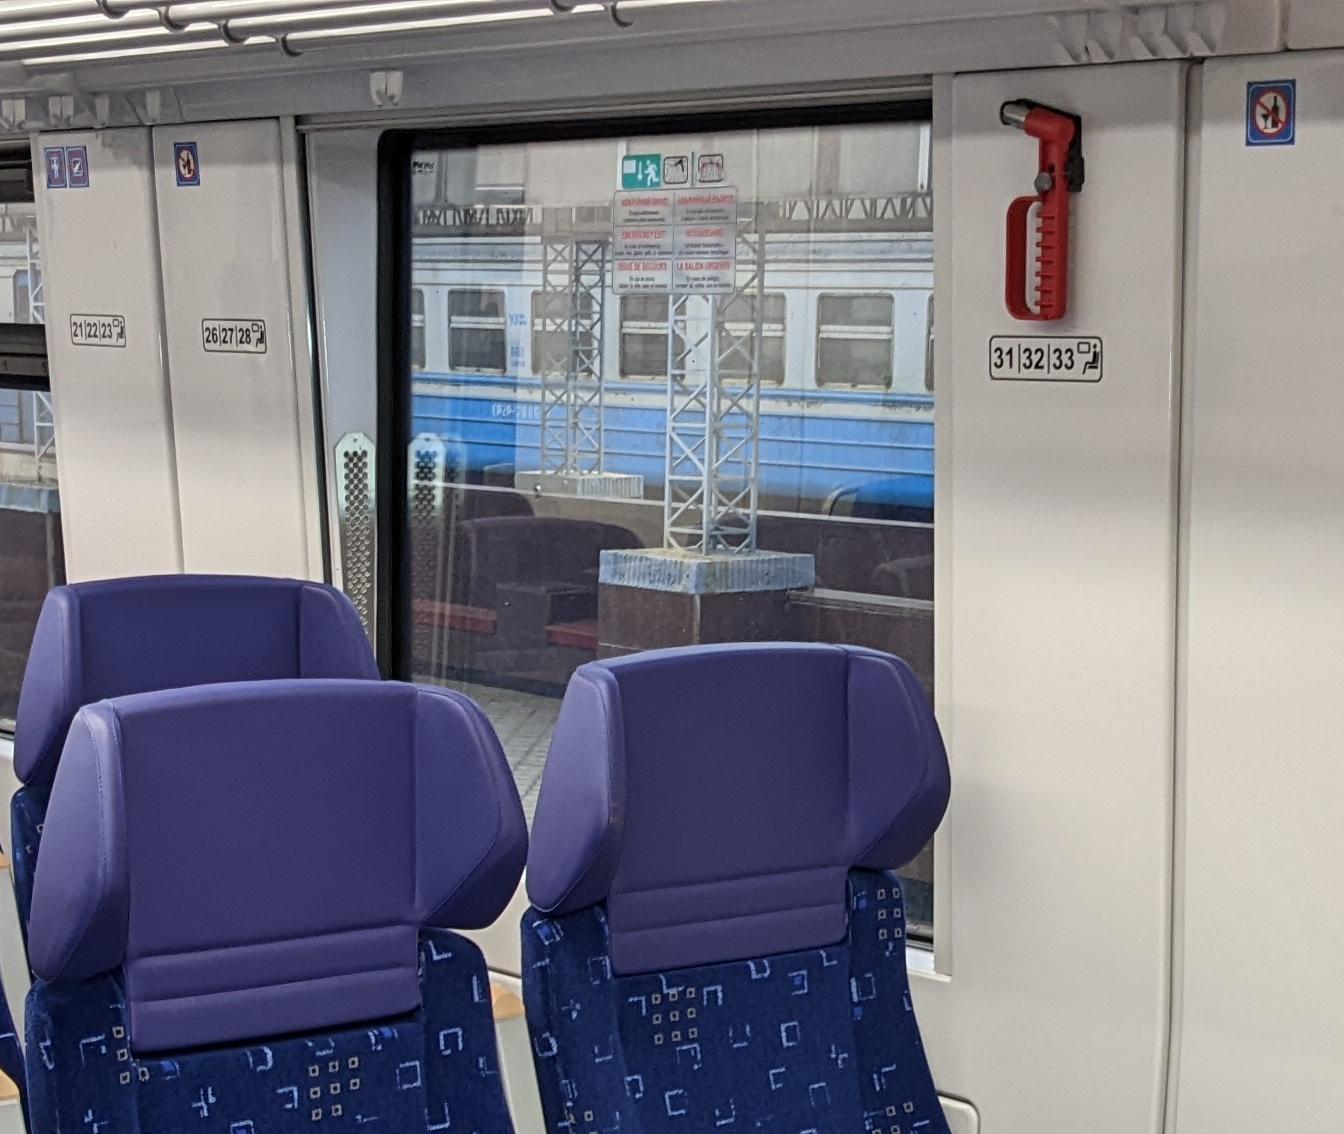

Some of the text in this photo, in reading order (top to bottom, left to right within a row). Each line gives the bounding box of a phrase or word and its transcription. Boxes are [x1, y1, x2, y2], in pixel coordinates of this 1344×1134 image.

[205, 327, 252, 345] 26 27 28
[993, 346, 1075, 370] 31 32 33
